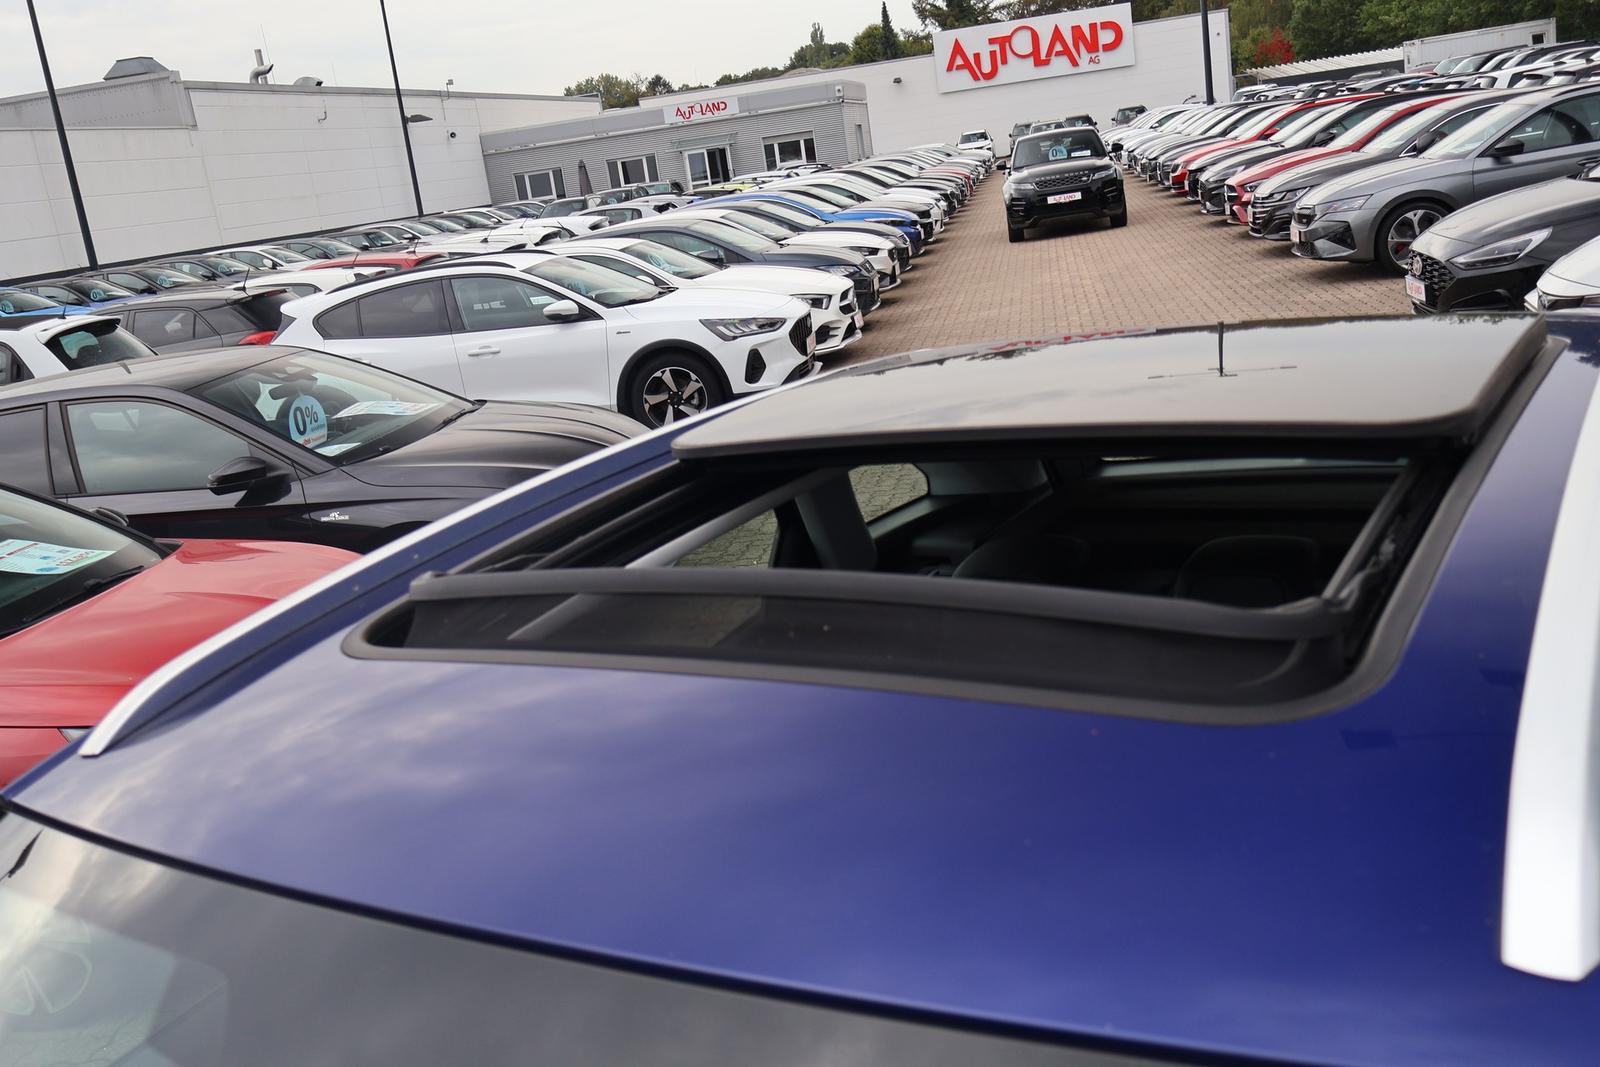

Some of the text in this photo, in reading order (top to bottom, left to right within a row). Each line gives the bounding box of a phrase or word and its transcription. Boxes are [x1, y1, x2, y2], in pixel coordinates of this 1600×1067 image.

[946, 20, 1123, 81] AUTOLAND
[1088, 55, 1100, 65] AG
[675, 101, 728, 120] AUTOLAND
[293, 405, 319, 436] 0%
